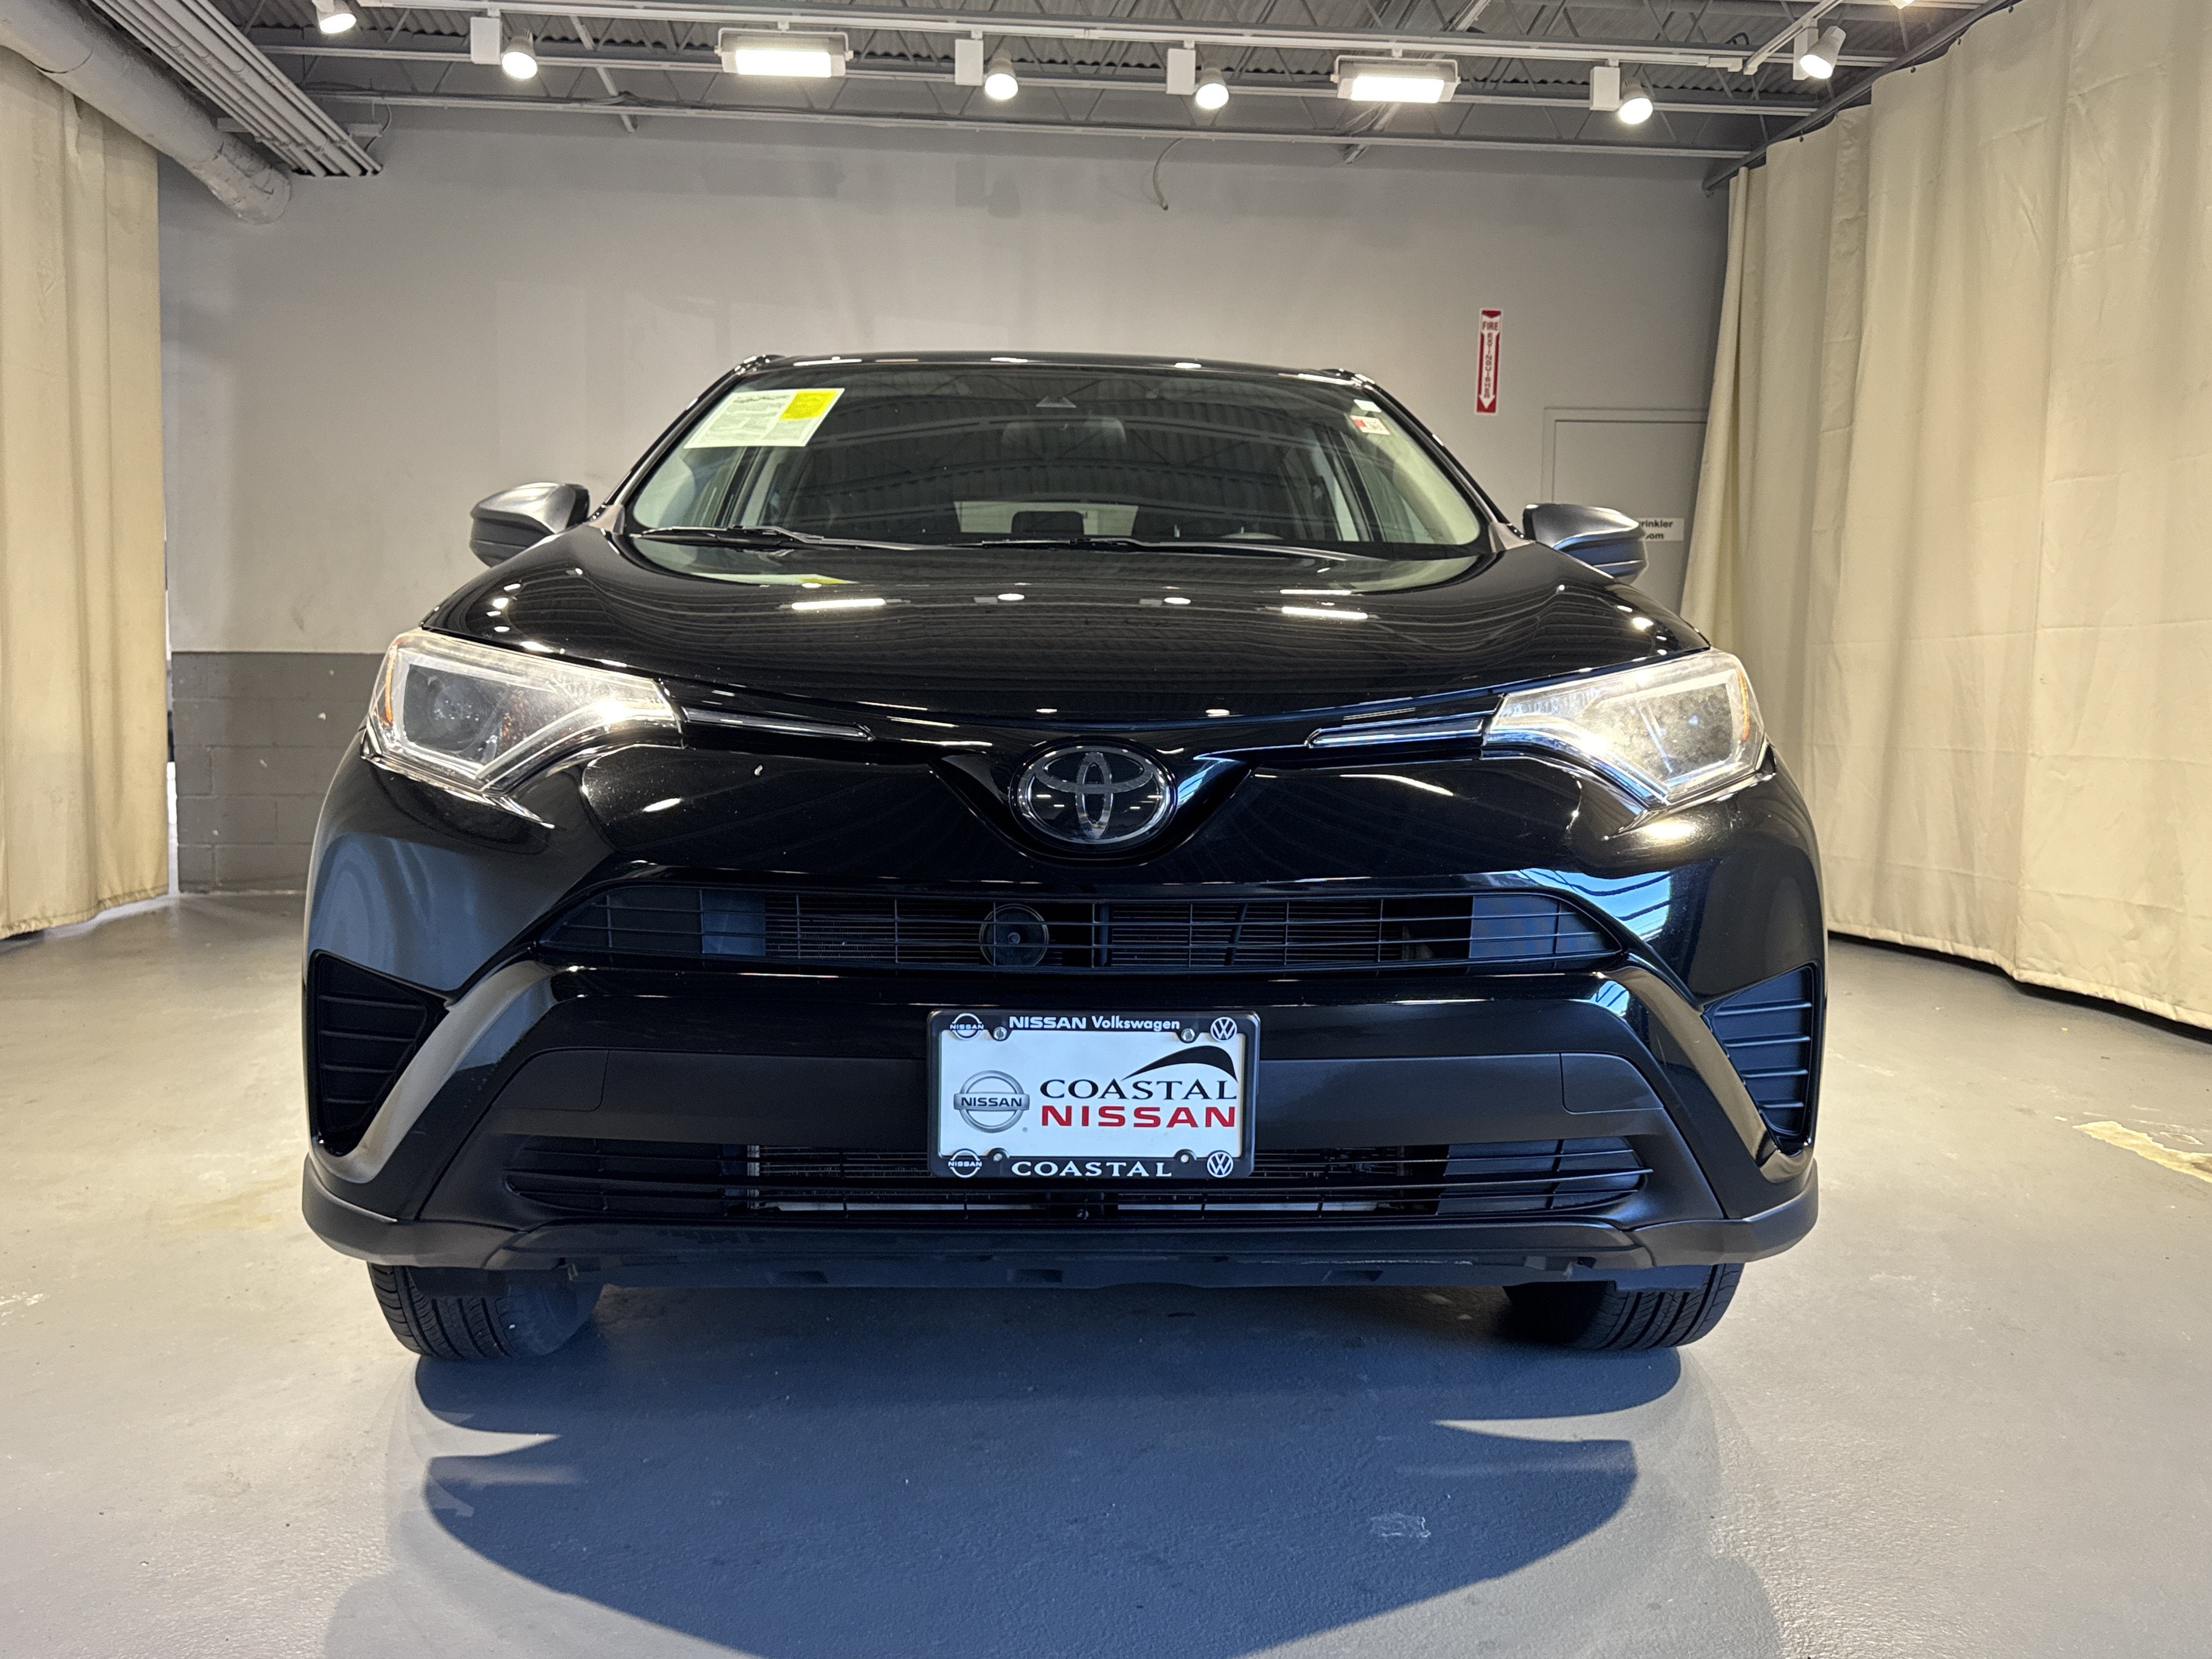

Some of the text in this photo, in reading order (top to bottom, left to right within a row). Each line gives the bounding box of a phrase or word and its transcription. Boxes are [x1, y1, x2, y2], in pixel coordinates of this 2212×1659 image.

[1482, 321, 1499, 331] FIRE
[1483, 332, 1493, 399] EXTINGUISHER
[1640, 520, 1673, 528] rinkler
[1009, 1015, 1180, 1032] NISSAN Volkswagen
[1210, 1017, 1238, 1042] VW
[1039, 1077, 1238, 1101] COASTAL
[961, 1097, 1023, 1107] NISSAN
[1041, 1105, 1236, 1128] NISSAN
[1011, 1160, 1172, 1177] COASTAL
[1206, 1152, 1234, 1178] VW
